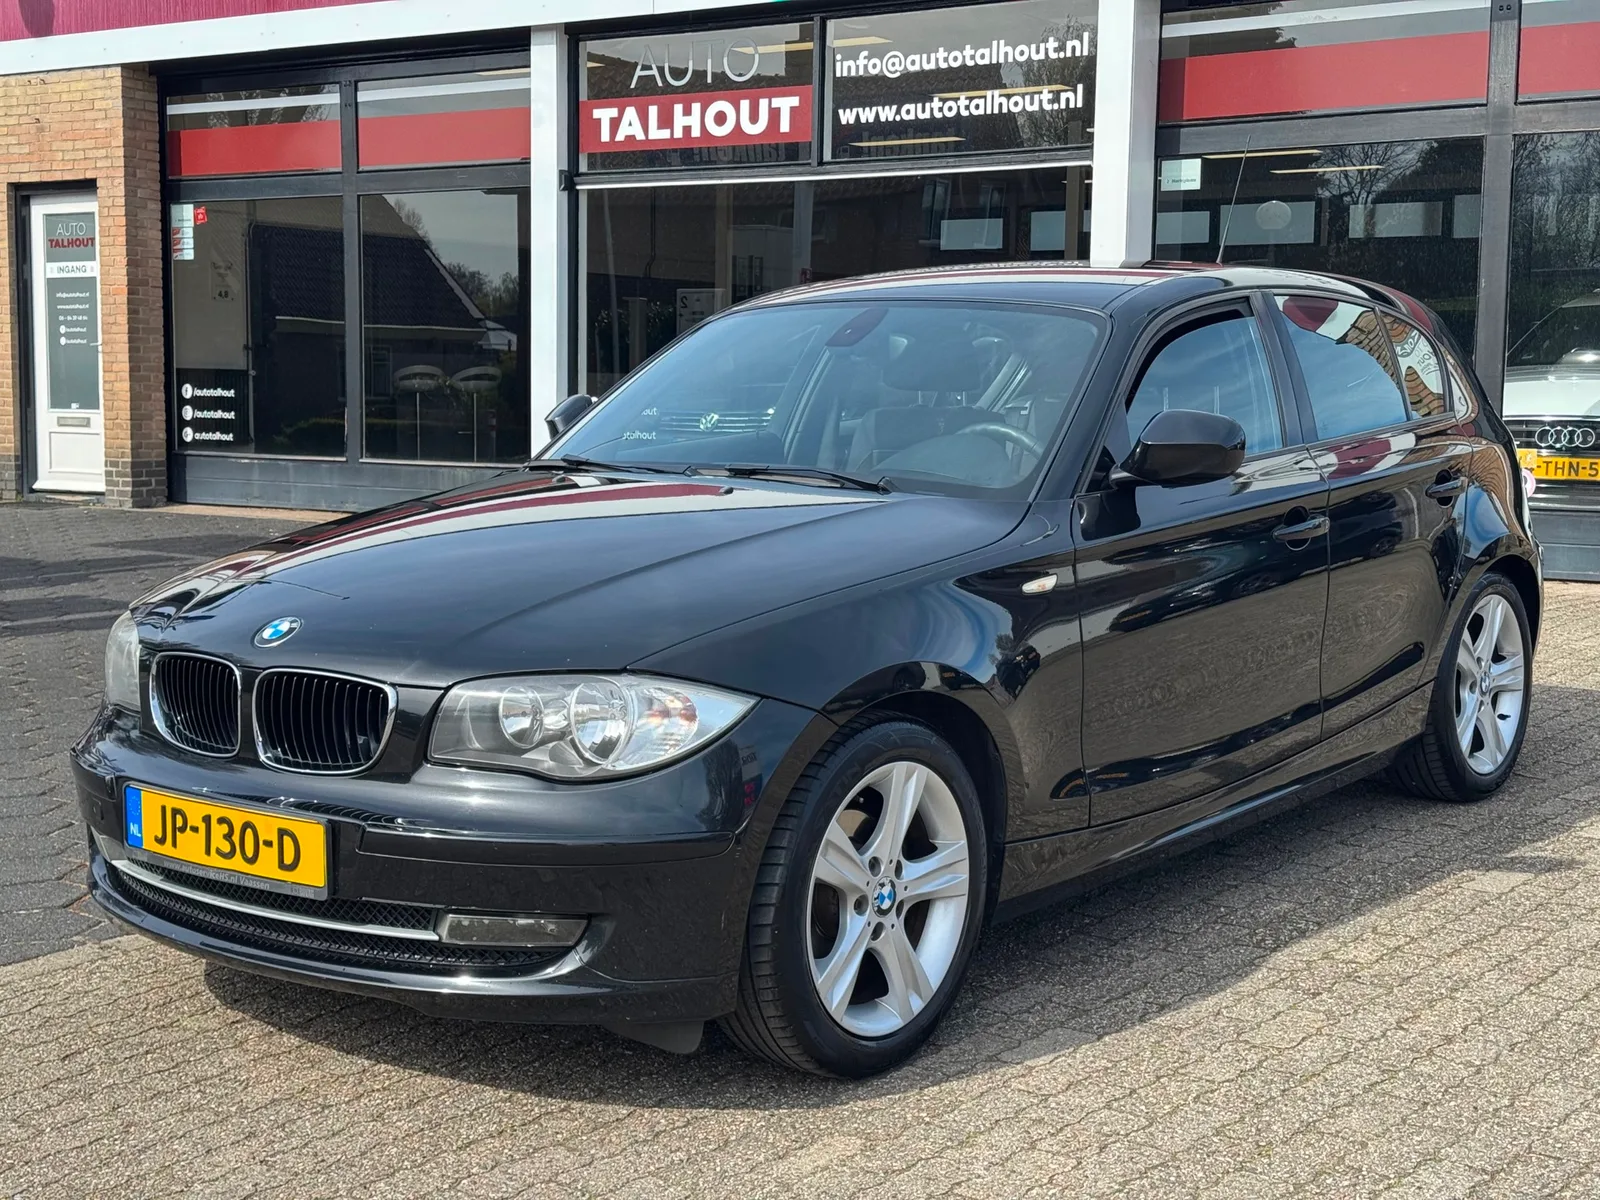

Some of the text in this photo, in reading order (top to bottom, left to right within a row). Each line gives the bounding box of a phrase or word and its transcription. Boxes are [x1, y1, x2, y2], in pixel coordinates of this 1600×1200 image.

[630, 37, 760, 88] AUTO
[836, 32, 1089, 78] info@autotalhout.nl
[838, 83, 1083, 125] www.autotalhout.nl
[592, 95, 800, 143] TALHOUT
[56, 222, 86, 236] AUTO
[48, 237, 95, 248] TALHOUT
[57, 265, 87, 274] INGANG
[194, 431, 234, 441] autotalhout
[130, 822, 141, 837] NL
[154, 804, 301, 872] JP-130-D
[239, 874, 270, 890] Vaassen
